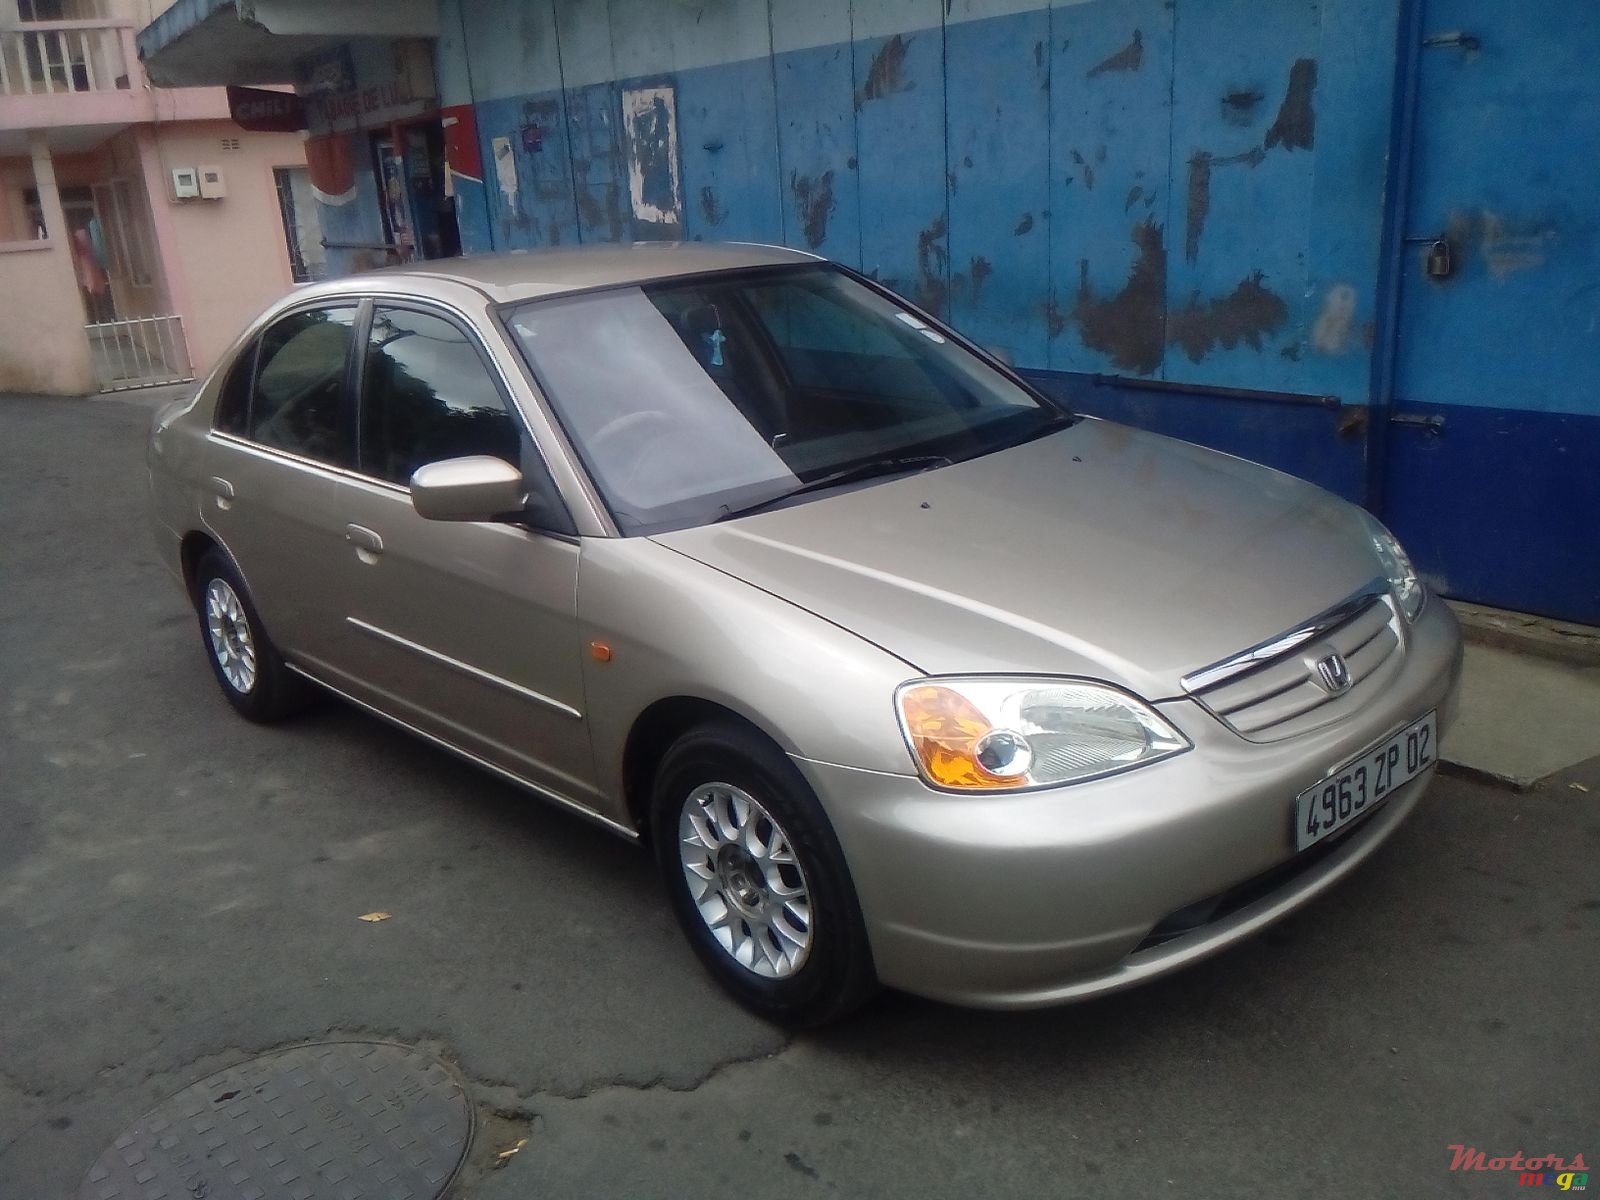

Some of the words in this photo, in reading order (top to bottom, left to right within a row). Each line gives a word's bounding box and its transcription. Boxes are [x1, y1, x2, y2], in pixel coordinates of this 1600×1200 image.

[1306, 766, 1367, 837] 4963
[1374, 743, 1399, 797] ZP
[1407, 724, 1431, 774] 02
